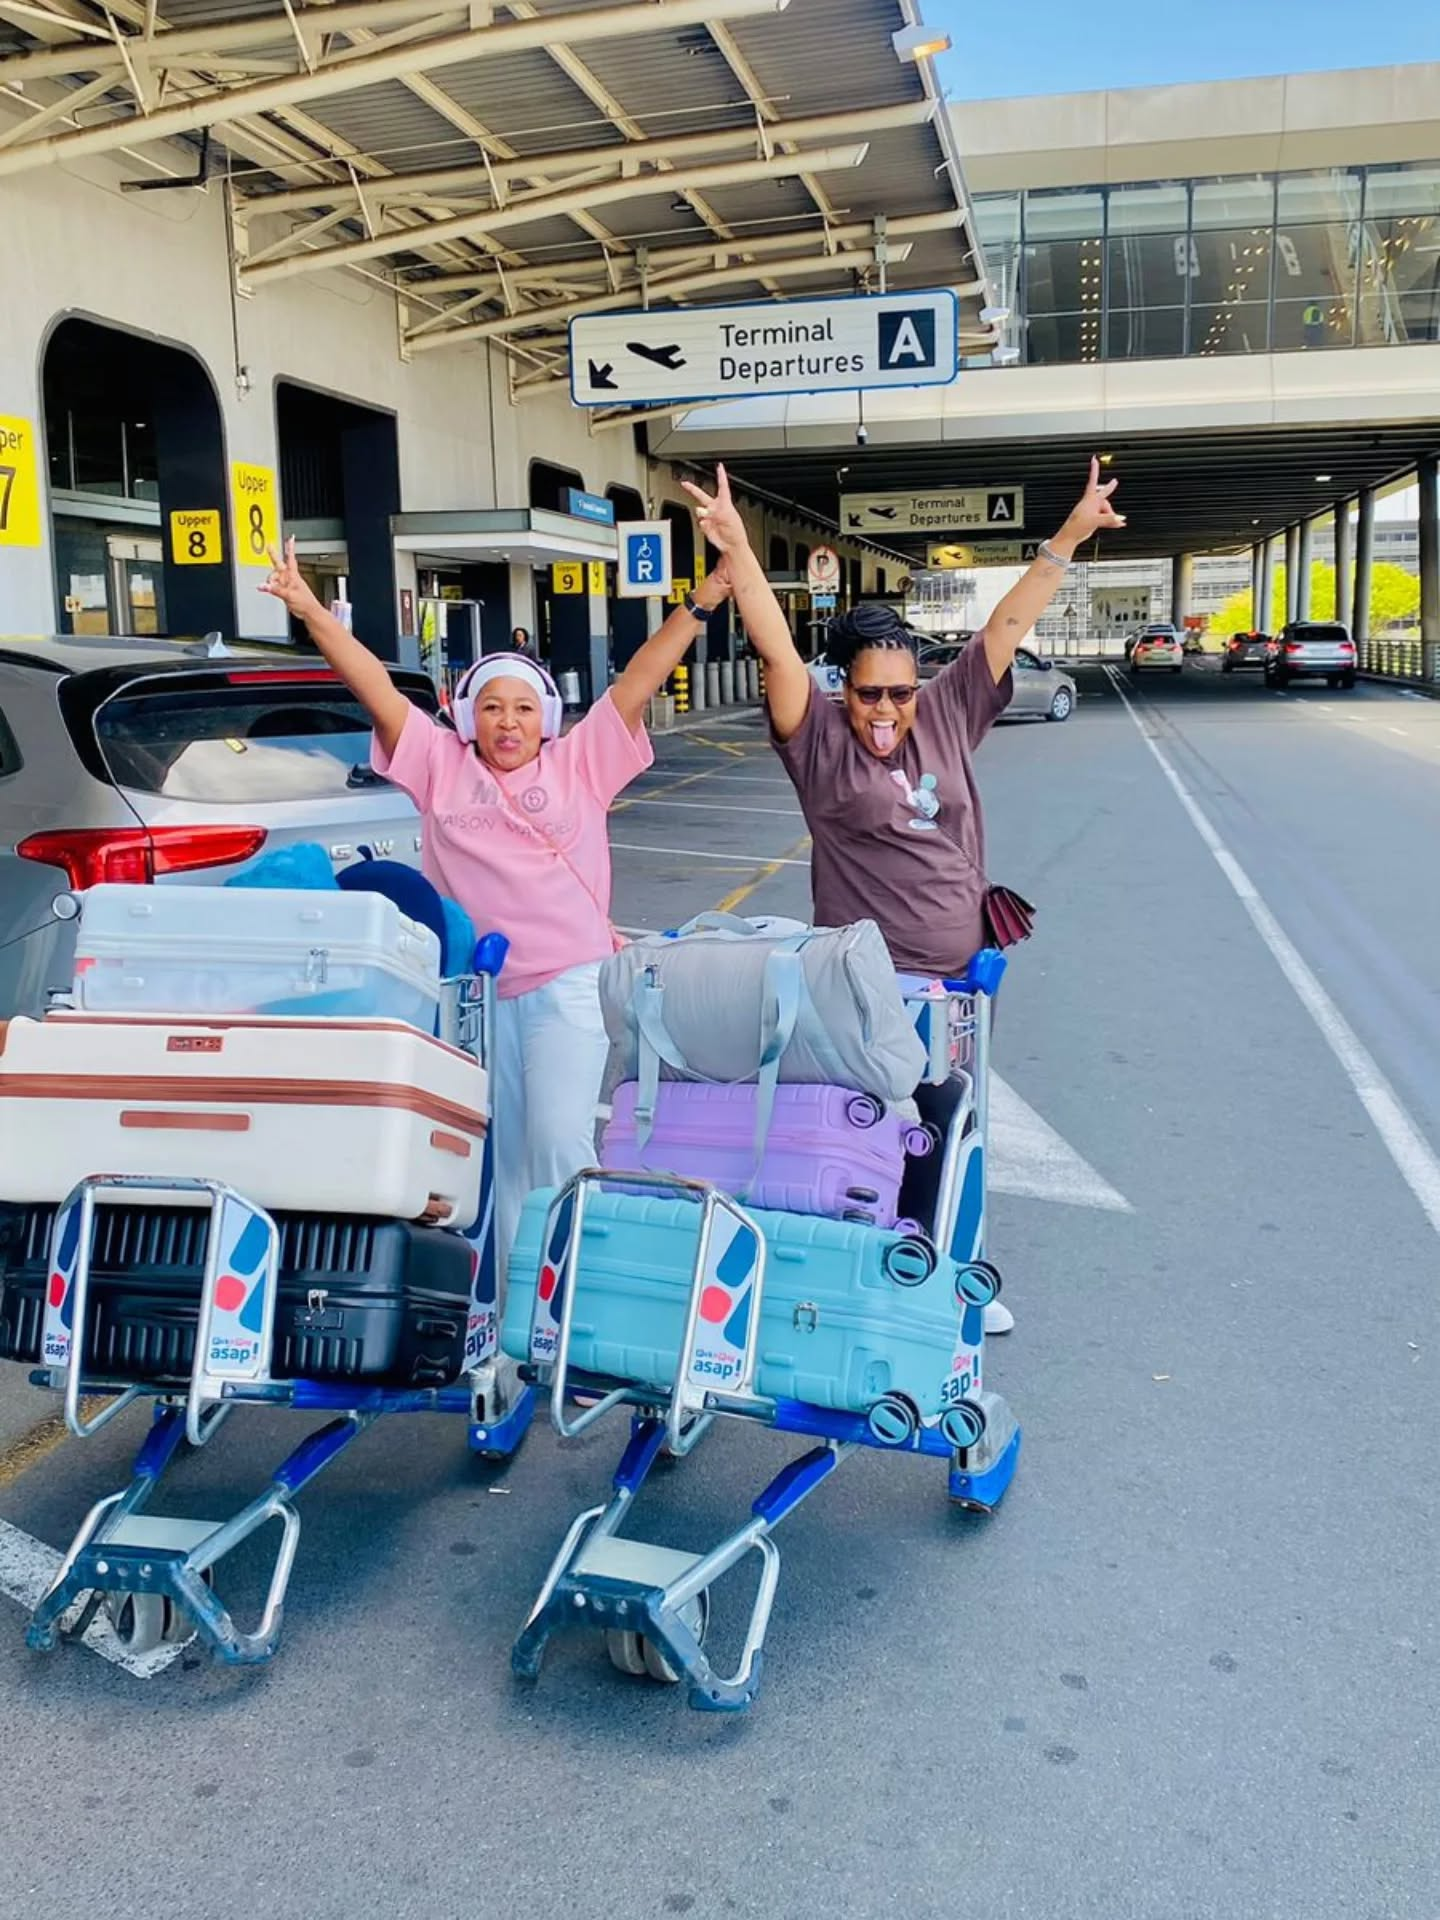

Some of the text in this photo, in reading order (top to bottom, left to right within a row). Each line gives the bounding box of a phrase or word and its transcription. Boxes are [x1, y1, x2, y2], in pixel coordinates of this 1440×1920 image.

[719, 316, 833, 347] Terminal
[888, 316, 926, 364] A
[719, 353, 865, 384] Departures
[0, 428, 23, 455] per
[238, 468, 269, 496] Upper
[0, 464, 17, 531] 7
[910, 496, 965, 510] Terminal
[991, 496, 1010, 519] A
[176, 514, 212, 528] Upper
[249, 502, 265, 555] 8
[910, 512, 981, 527] Departures
[188, 530, 207, 558] 8
[1025, 545, 1037, 559] A
[562, 574, 574, 590] 9
[637, 560, 653, 581] R
[441, 814, 496, 831] AISON
[45, 1338, 69, 1361] asap!
[210, 1342, 259, 1363] asap!
[694, 1359, 742, 1380] asap!
[940, 1354, 979, 1402] sap!
